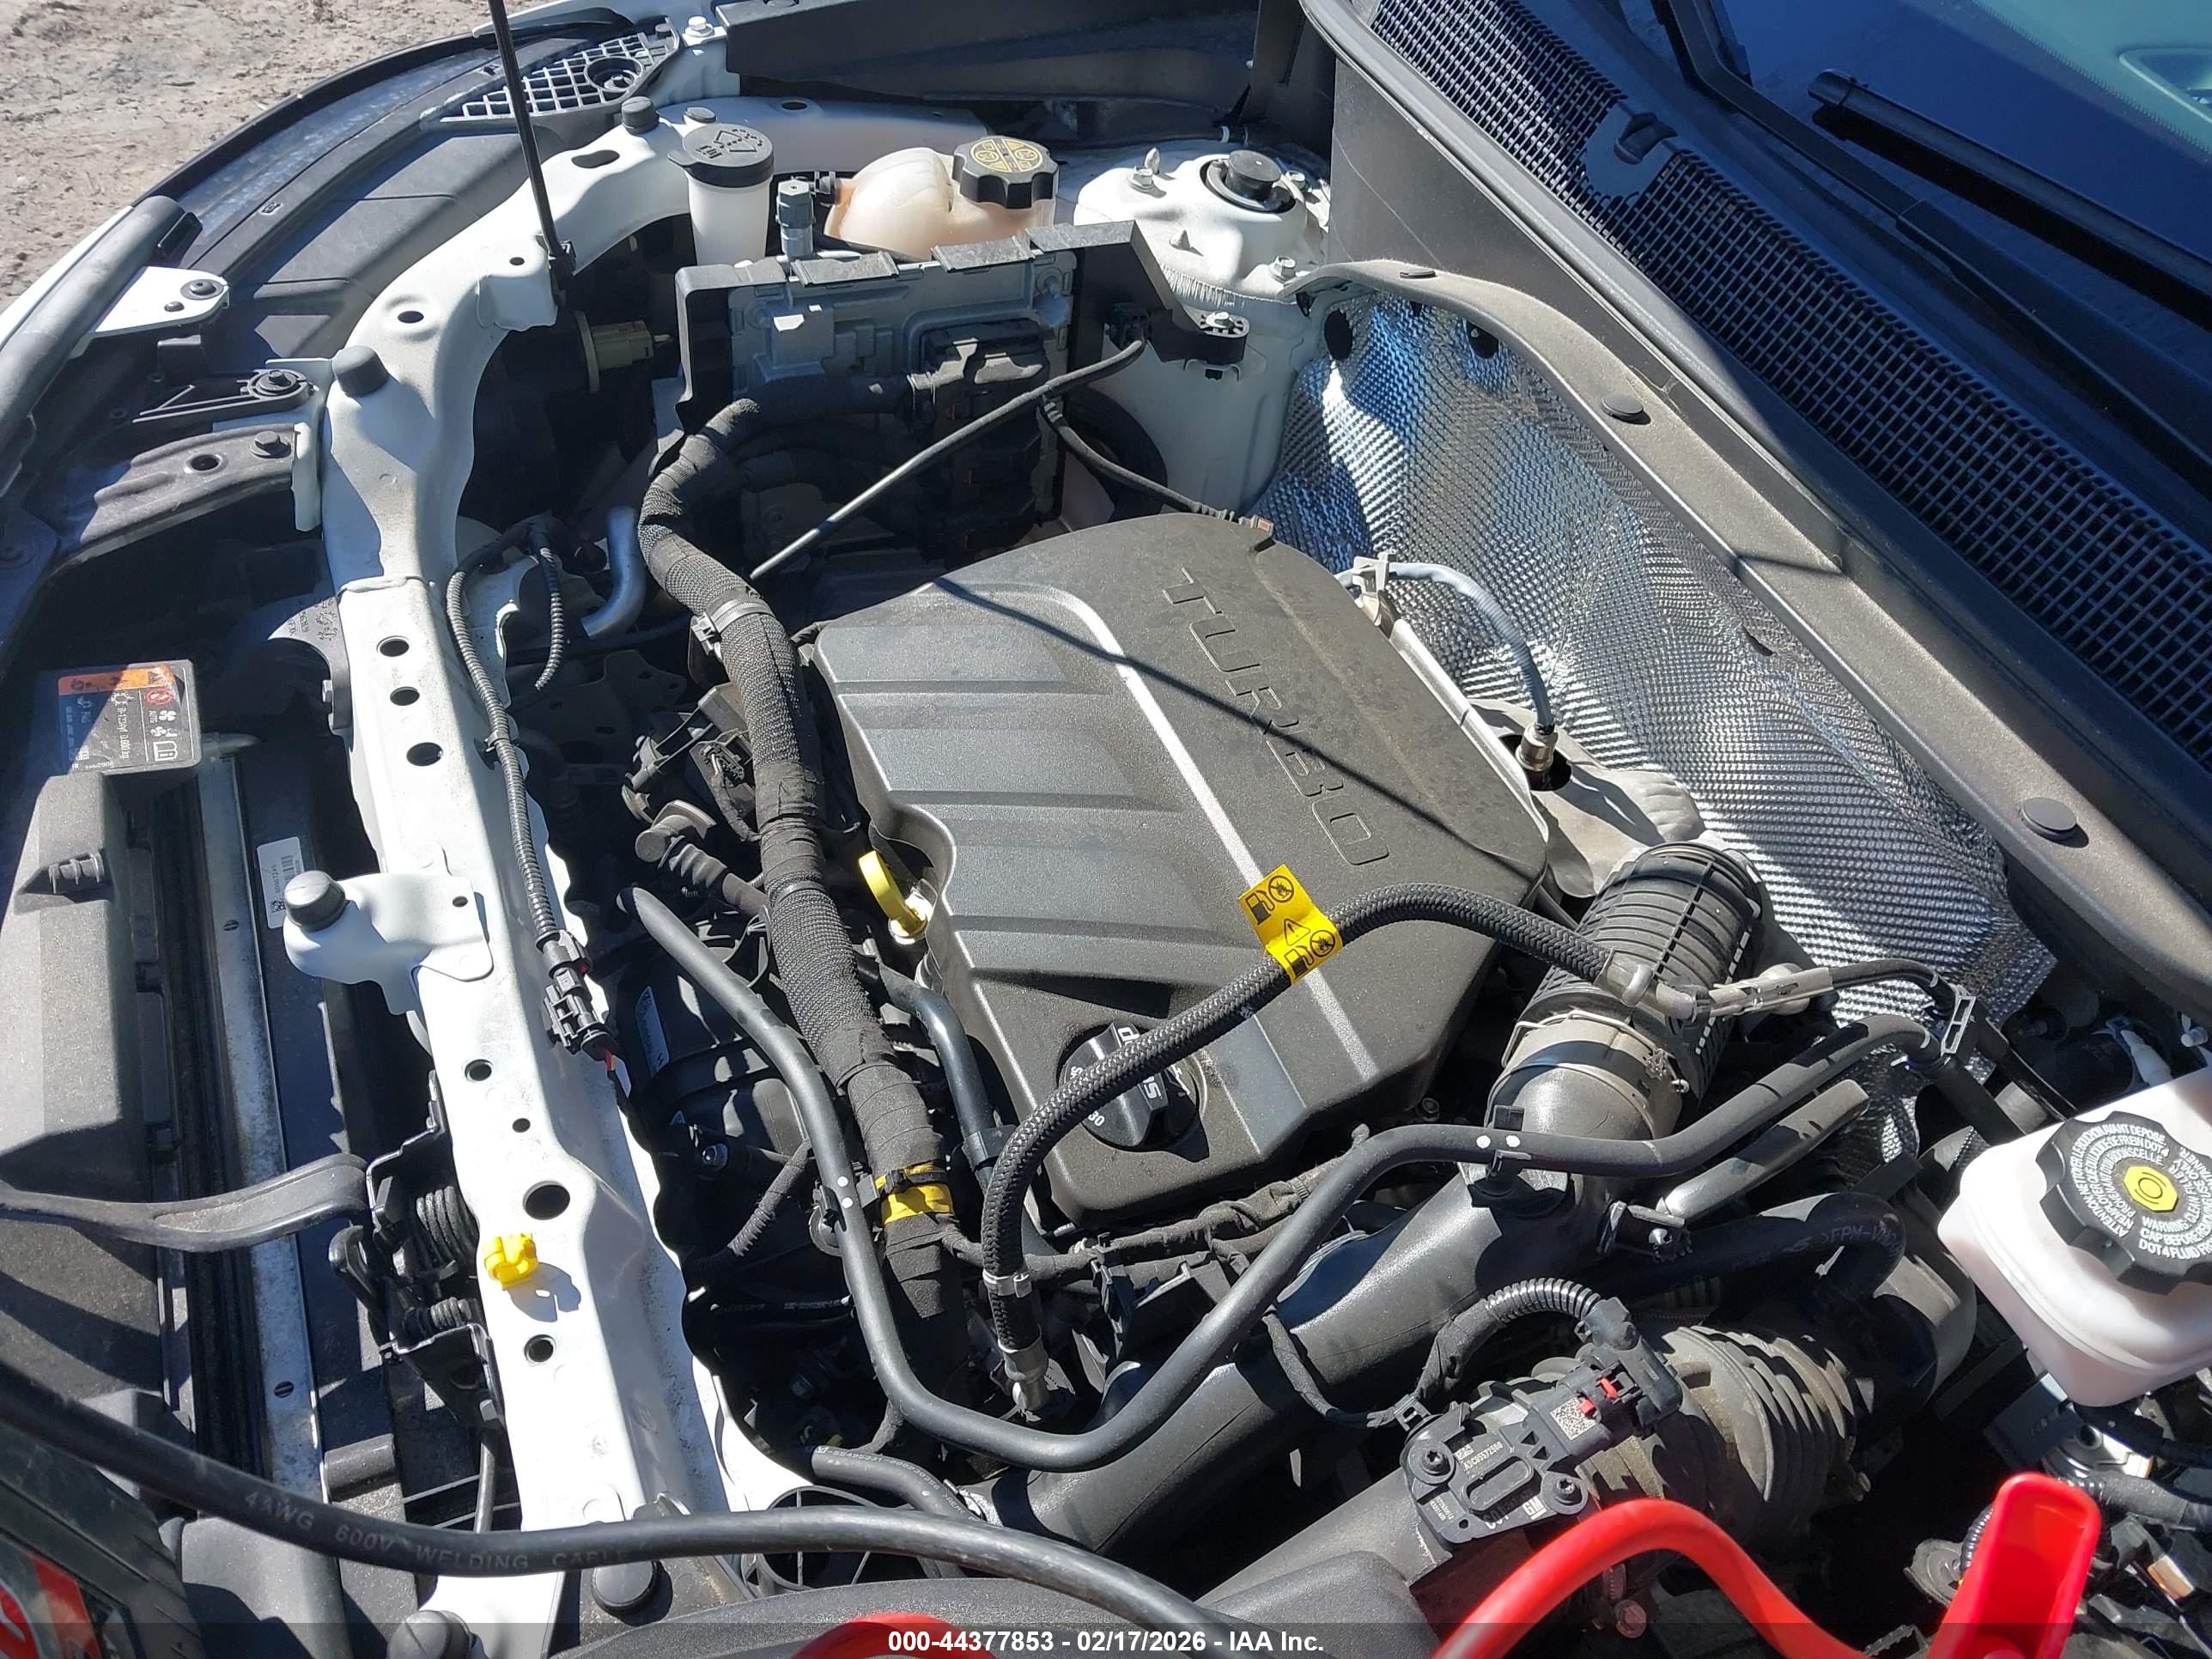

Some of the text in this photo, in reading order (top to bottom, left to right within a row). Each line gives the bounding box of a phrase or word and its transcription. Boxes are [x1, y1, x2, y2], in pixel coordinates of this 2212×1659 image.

[1162, 567, 1389, 866] TURBO
[2143, 1138, 2163, 1154] DOT
[2167, 1163, 2198, 1194] FILLER
[2172, 1155, 2201, 1180] ONLY
[2099, 1171, 2136, 1218] PROVENANT
[2191, 1179, 2212, 1198] USE
[2182, 1194, 2202, 1224] CLEAN
[2138, 1237, 2163, 1256] DOT
[2167, 1244, 2202, 1259] FLUID
[2142, 1226, 2164, 1244] CAP
[336, 1523, 394, 1553] 600V
[416, 1545, 529, 1570] WELDING
